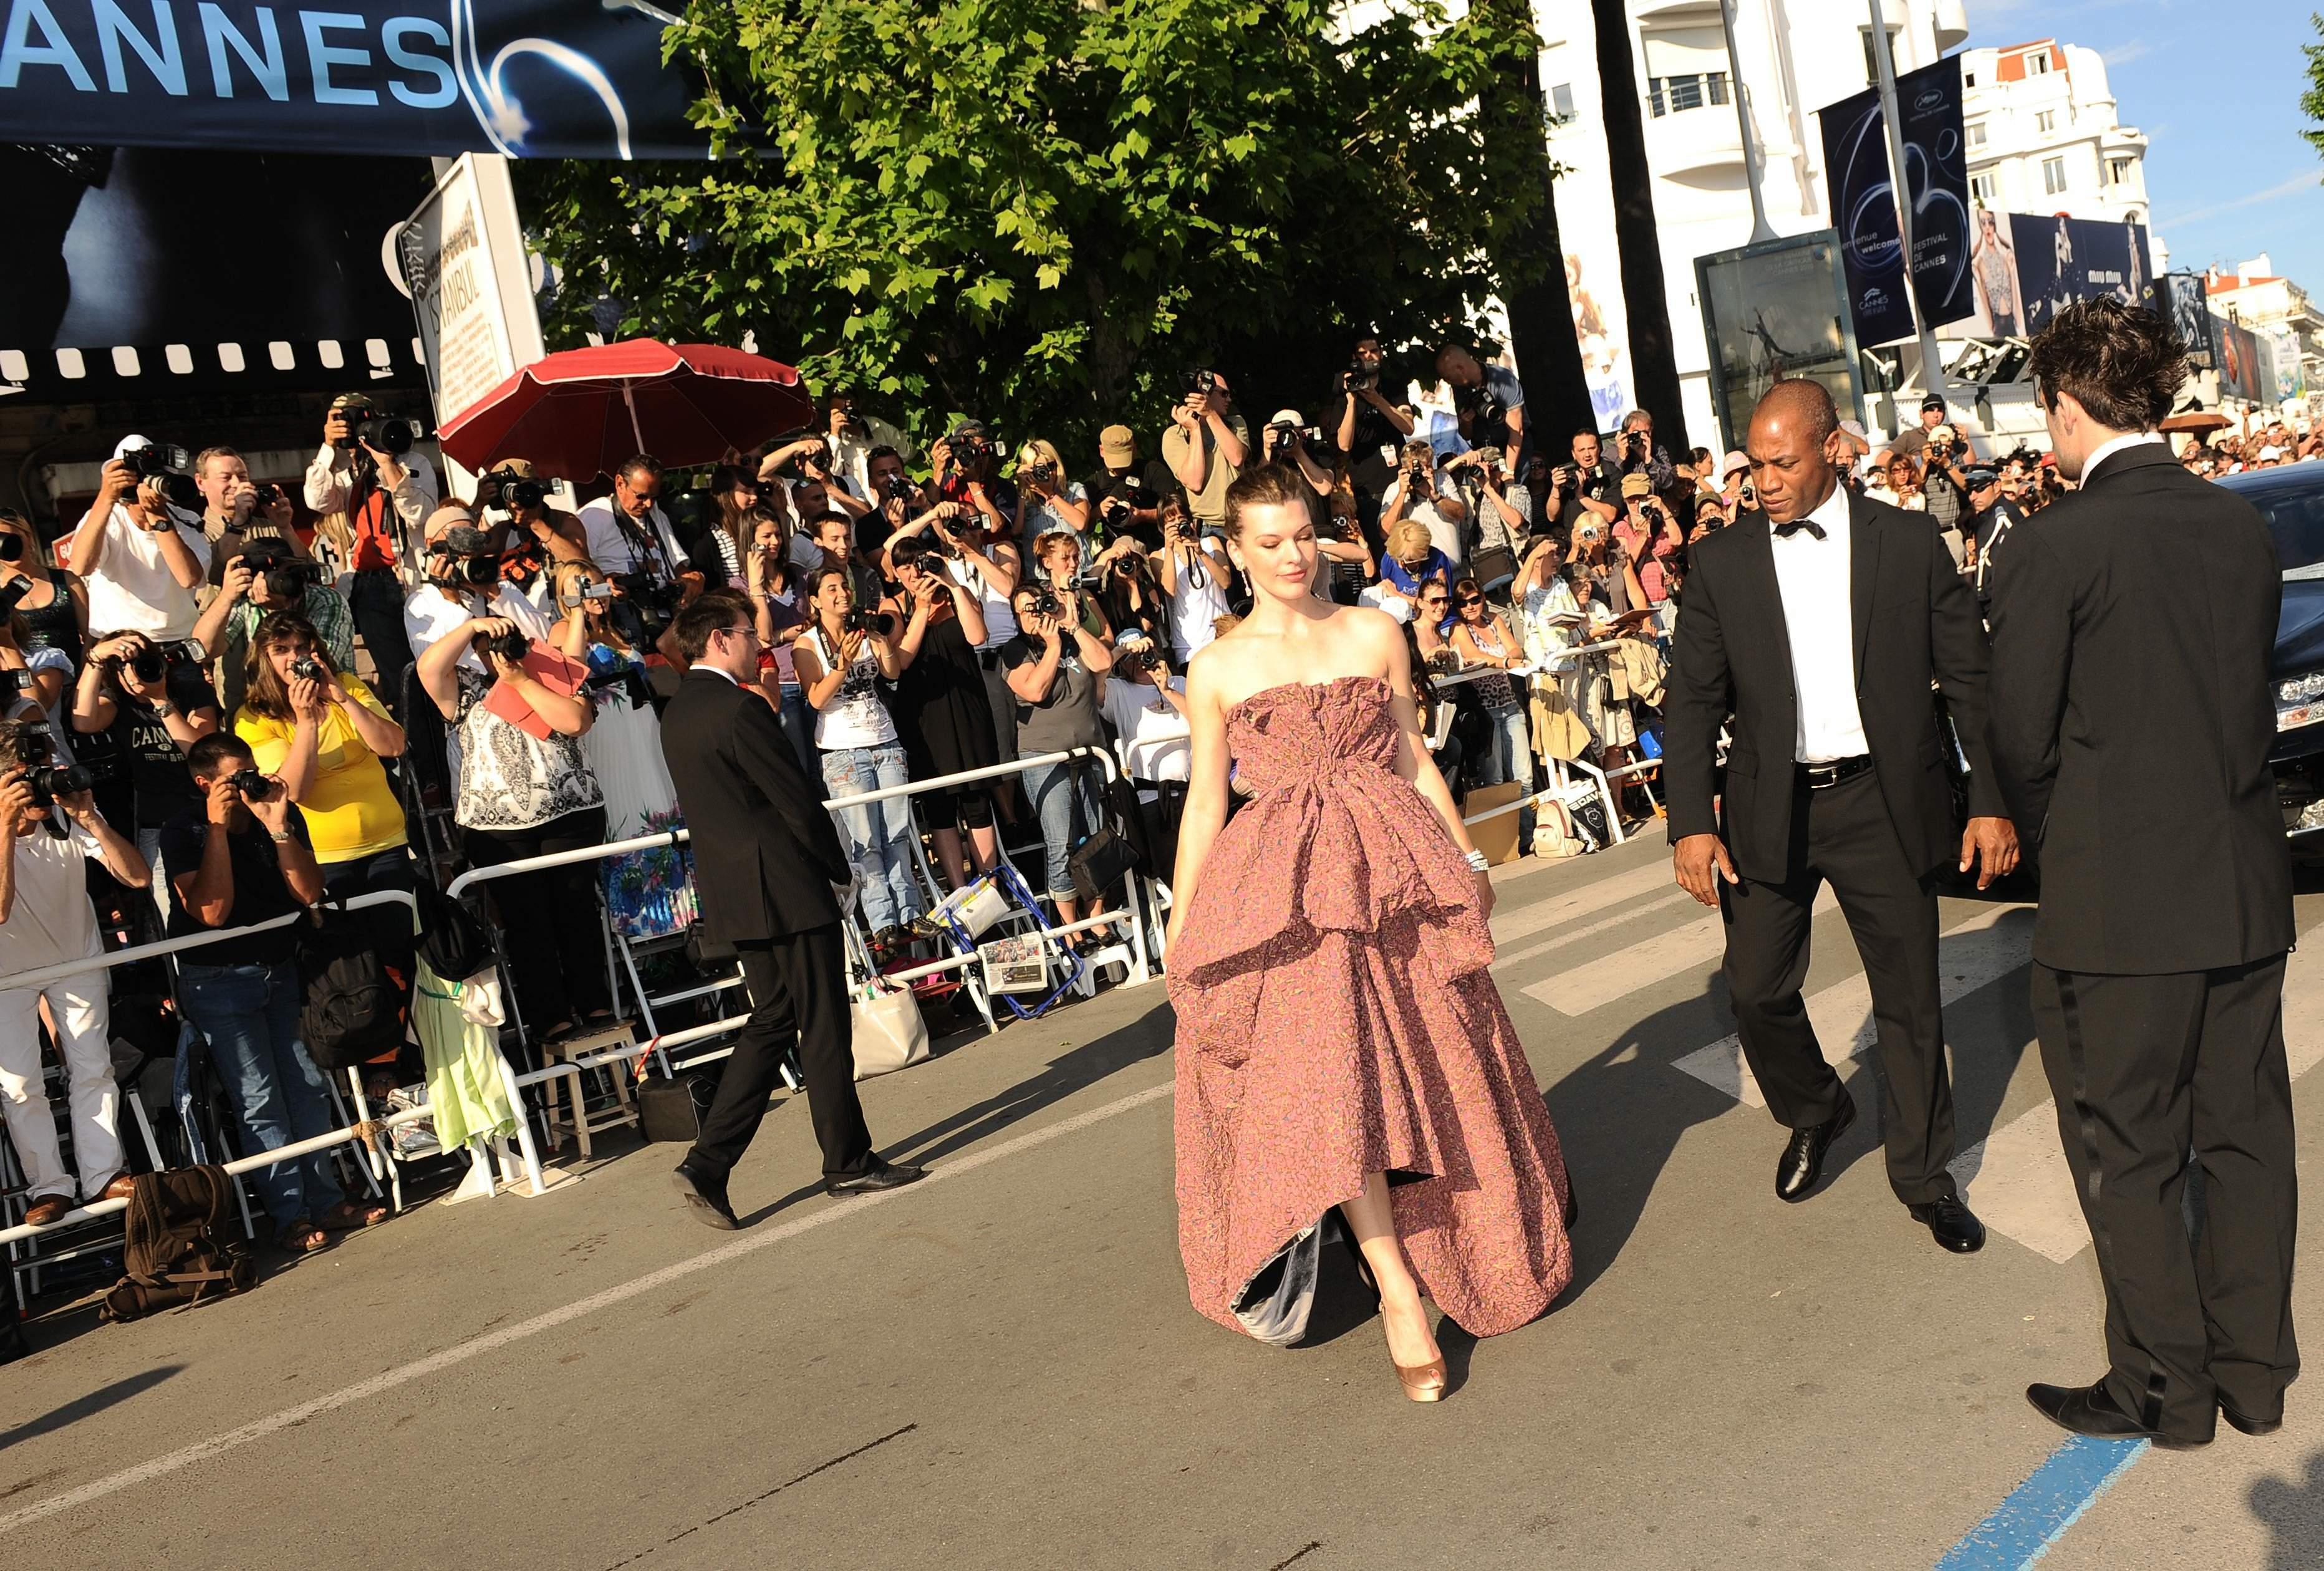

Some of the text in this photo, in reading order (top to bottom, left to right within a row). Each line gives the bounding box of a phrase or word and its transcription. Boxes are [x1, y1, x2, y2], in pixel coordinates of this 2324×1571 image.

[0, 0, 459, 109] ANNES
[1861, 238, 1901, 254] welcome
[1914, 233, 1948, 251] FESTIVAL
[1914, 252, 1922, 262] DE
[1914, 254, 1946, 273] CANNES
[427, 258, 480, 337] ISTANBUL
[1859, 294, 1889, 310] CANNES
[132, 726, 173, 748] CANN
